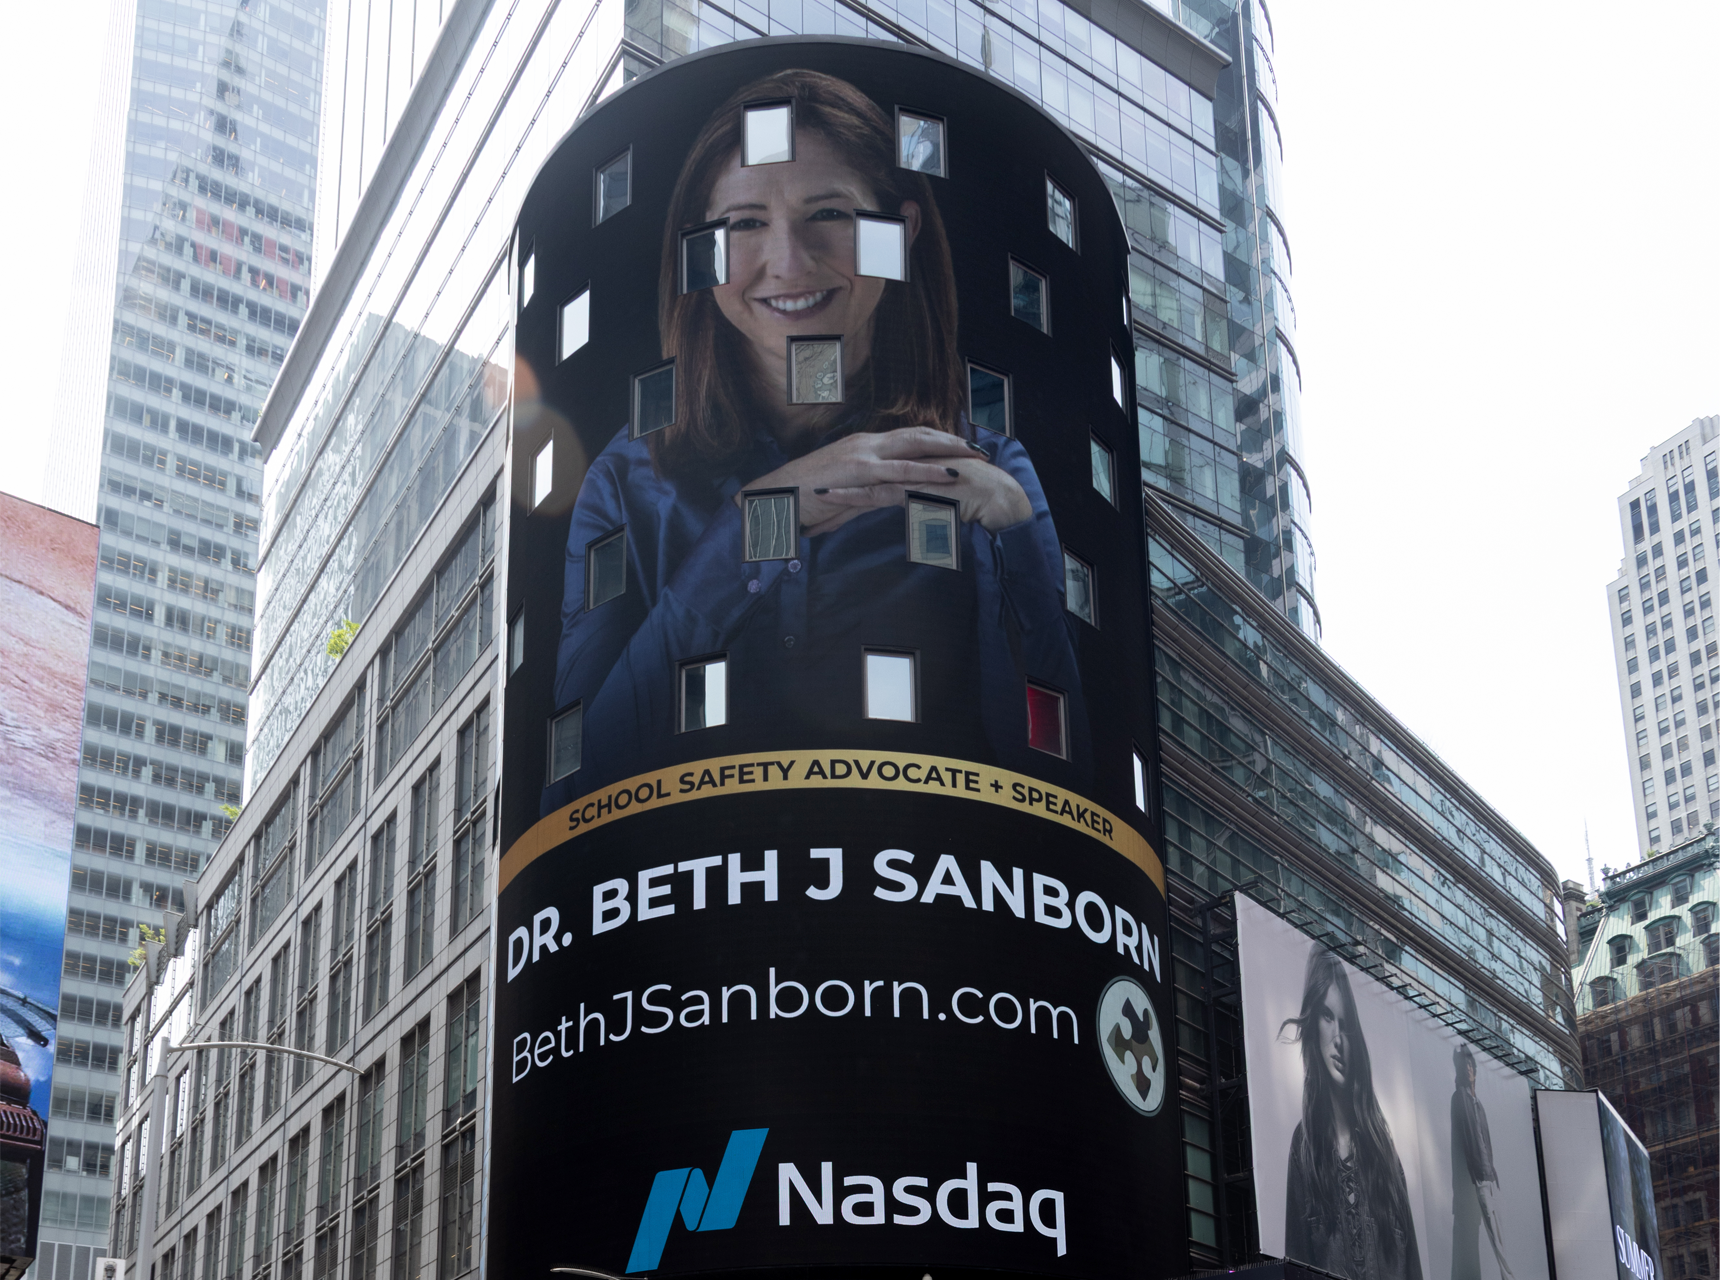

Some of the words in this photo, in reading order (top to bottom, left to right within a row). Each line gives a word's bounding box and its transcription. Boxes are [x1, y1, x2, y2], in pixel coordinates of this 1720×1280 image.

[569, 778, 672, 831] SCHOOL
[679, 759, 796, 794] SAFETY
[804, 758, 981, 793] ADVOCATE
[989, 779, 1004, 794] +
[1011, 781, 1114, 842] SPEAKER
[507, 905, 573, 983] DR.
[592, 849, 778, 936] BETH
[805, 847, 843, 901] J
[873, 848, 1161, 983] SANBORN
[511, 967, 1079, 1084] BethJSanborn.com
[778, 1161, 1067, 1258] Nasdaq
